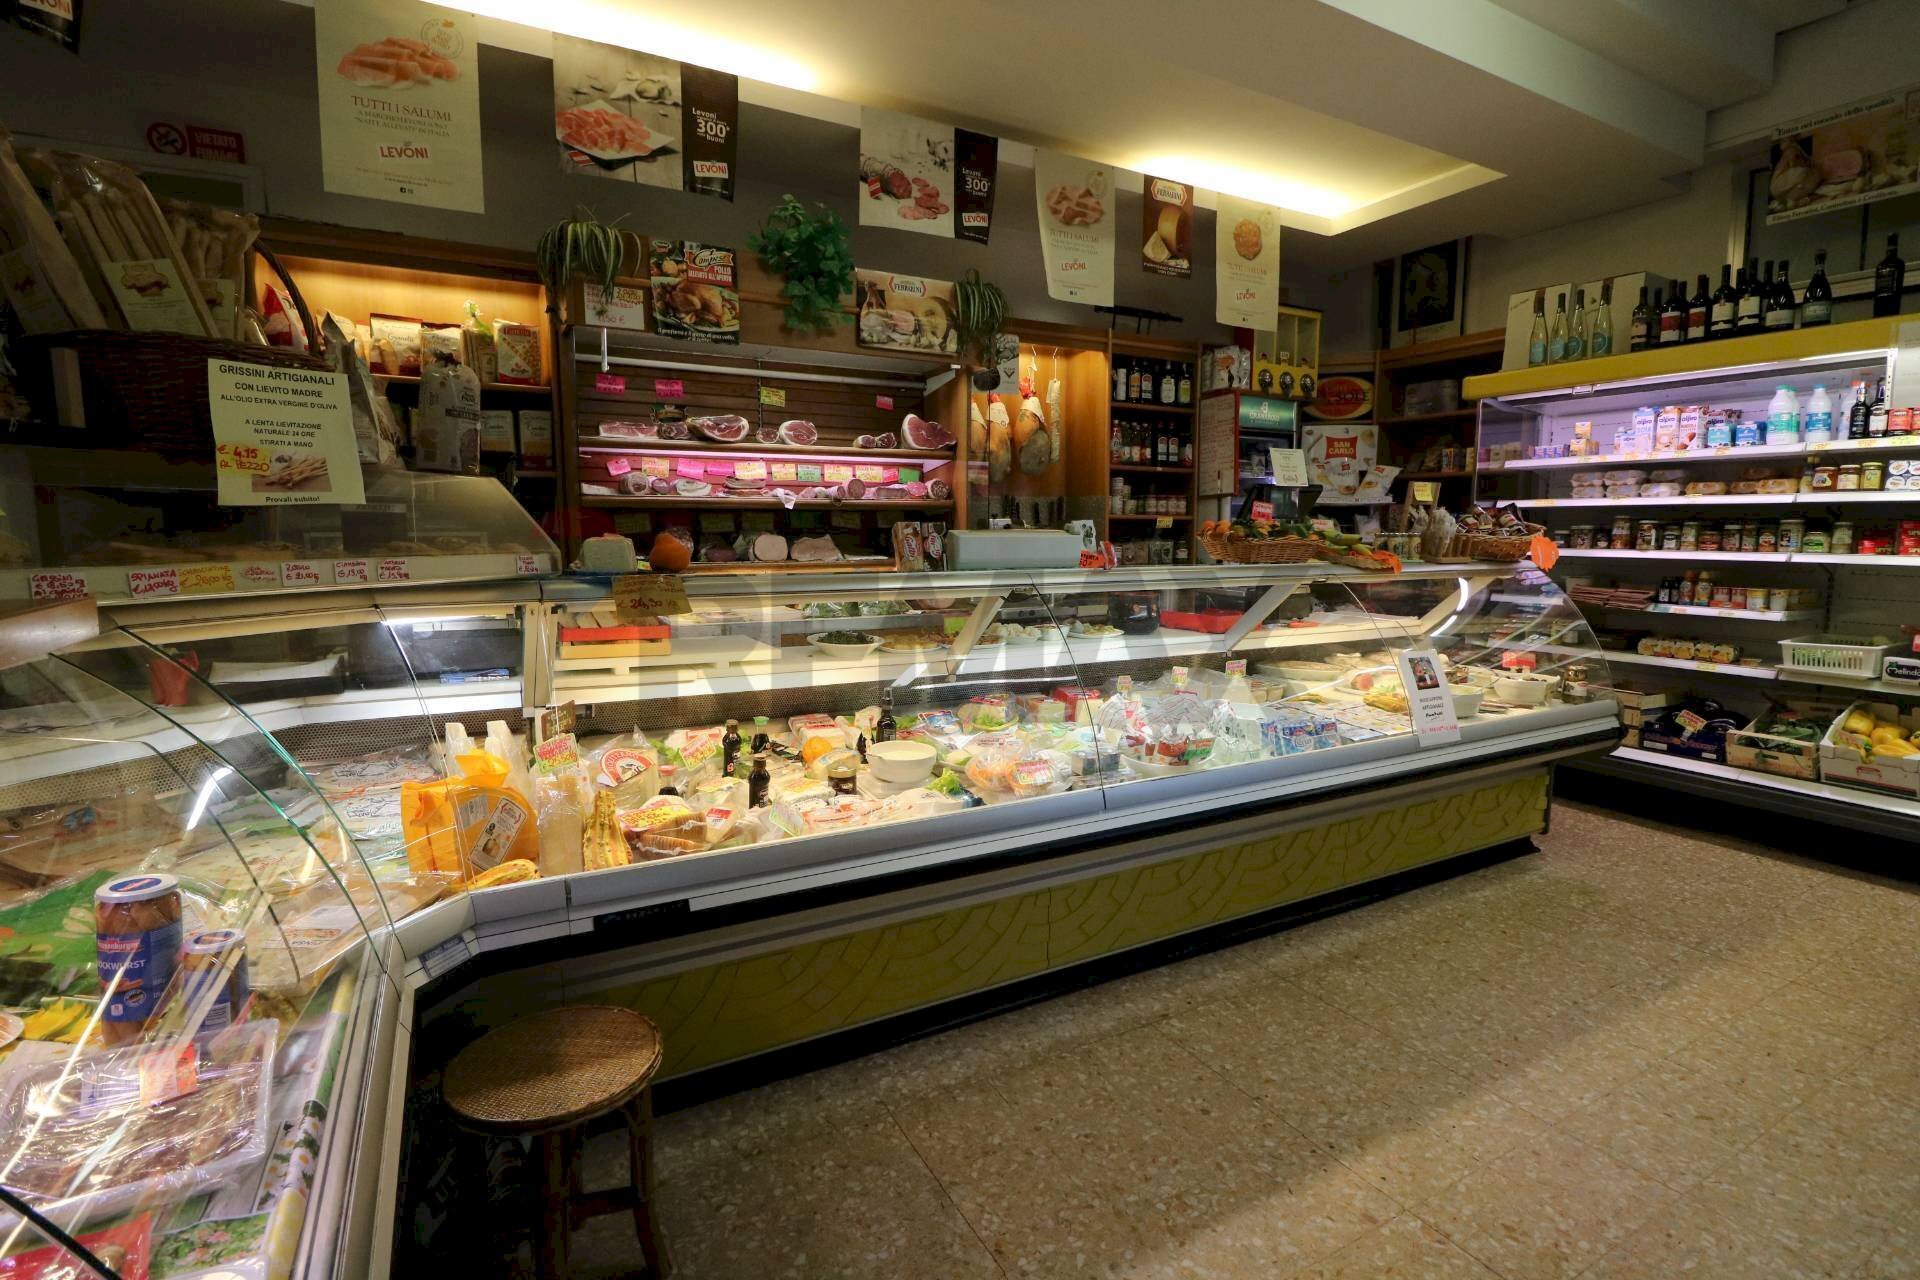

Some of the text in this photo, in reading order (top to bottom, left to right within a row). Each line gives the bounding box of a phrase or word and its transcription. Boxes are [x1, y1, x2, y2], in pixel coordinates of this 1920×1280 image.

[351, 95, 392, 112] TUTTI
[402, 103, 452, 121] SALUMI
[692, 107, 717, 119] Levoni
[195, 131, 237, 148] VIETATO
[706, 134, 725, 143] buoni
[380, 146, 429, 159] LEVONI
[695, 164, 727, 174] LEVONI
[964, 215, 988, 223] LEVONI
[714, 265, 732, 275] POLLO
[1061, 262, 1086, 271] LEVONI
[894, 283, 922, 293] FERRARINI
[219, 364, 335, 386] GRISSINI ARTIGIANALI
[234, 382, 323, 398] CON LIEVITO MADRE
[220, 394, 338, 410] ALL'OLIO EXTRA VERGINE D'OLIVA
[251, 419, 274, 427] LENTA
[276, 421, 322, 430] LIEVITAZIONE
[254, 428, 290, 436] NATURALE
[259, 439, 286, 447] STIRATI
[294, 440, 313, 448] MANO
[1333, 440, 1351, 448] SAN
[1328, 447, 1355, 455] CARLO
[236, 461, 270, 472] PEZZO
[131, 569, 176, 581] SPIANATA
